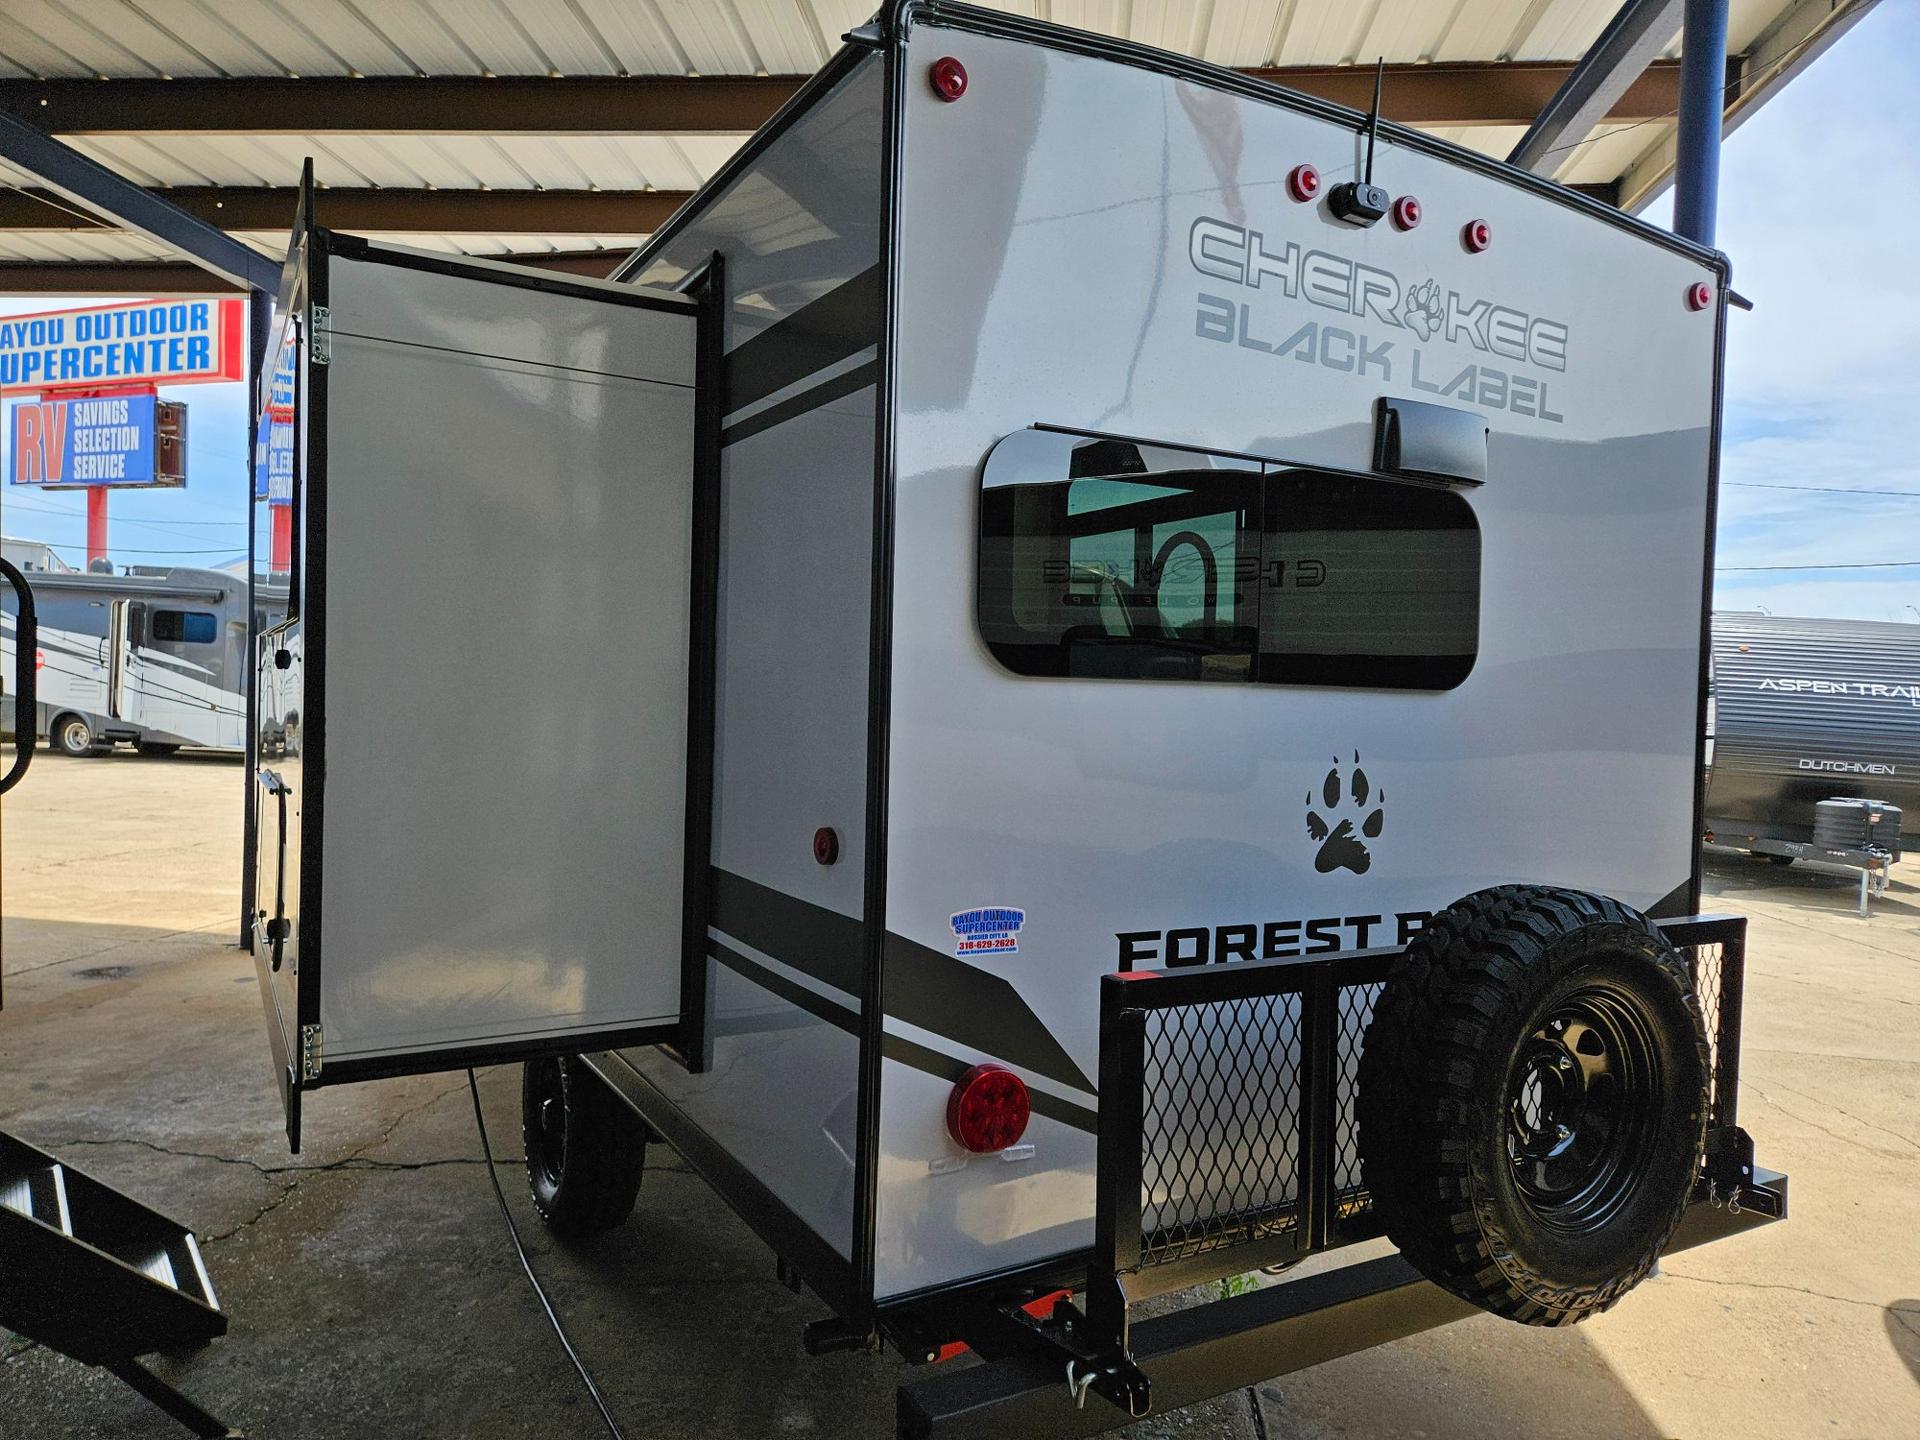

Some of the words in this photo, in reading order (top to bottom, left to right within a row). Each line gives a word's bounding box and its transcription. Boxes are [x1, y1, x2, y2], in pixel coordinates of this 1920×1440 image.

[75, 303, 209, 343] OUTDOOR
[1195, 292, 1396, 382] BLACK
[1411, 348, 1564, 424] LABEL
[74, 400, 128, 426] SAVINGS
[15, 402, 68, 484] RV
[74, 426, 139, 453] SELECTION
[73, 454, 125, 480] SERVICE
[1758, 678, 1848, 694] ASPEN
[1799, 759, 1896, 775] DUTCHMEN
[952, 910, 982, 926] BAYOU
[983, 908, 1024, 922] OUTDOOR
[955, 921, 1020, 934] SUPERCENTER
[1115, 914, 1382, 972] FOREST
